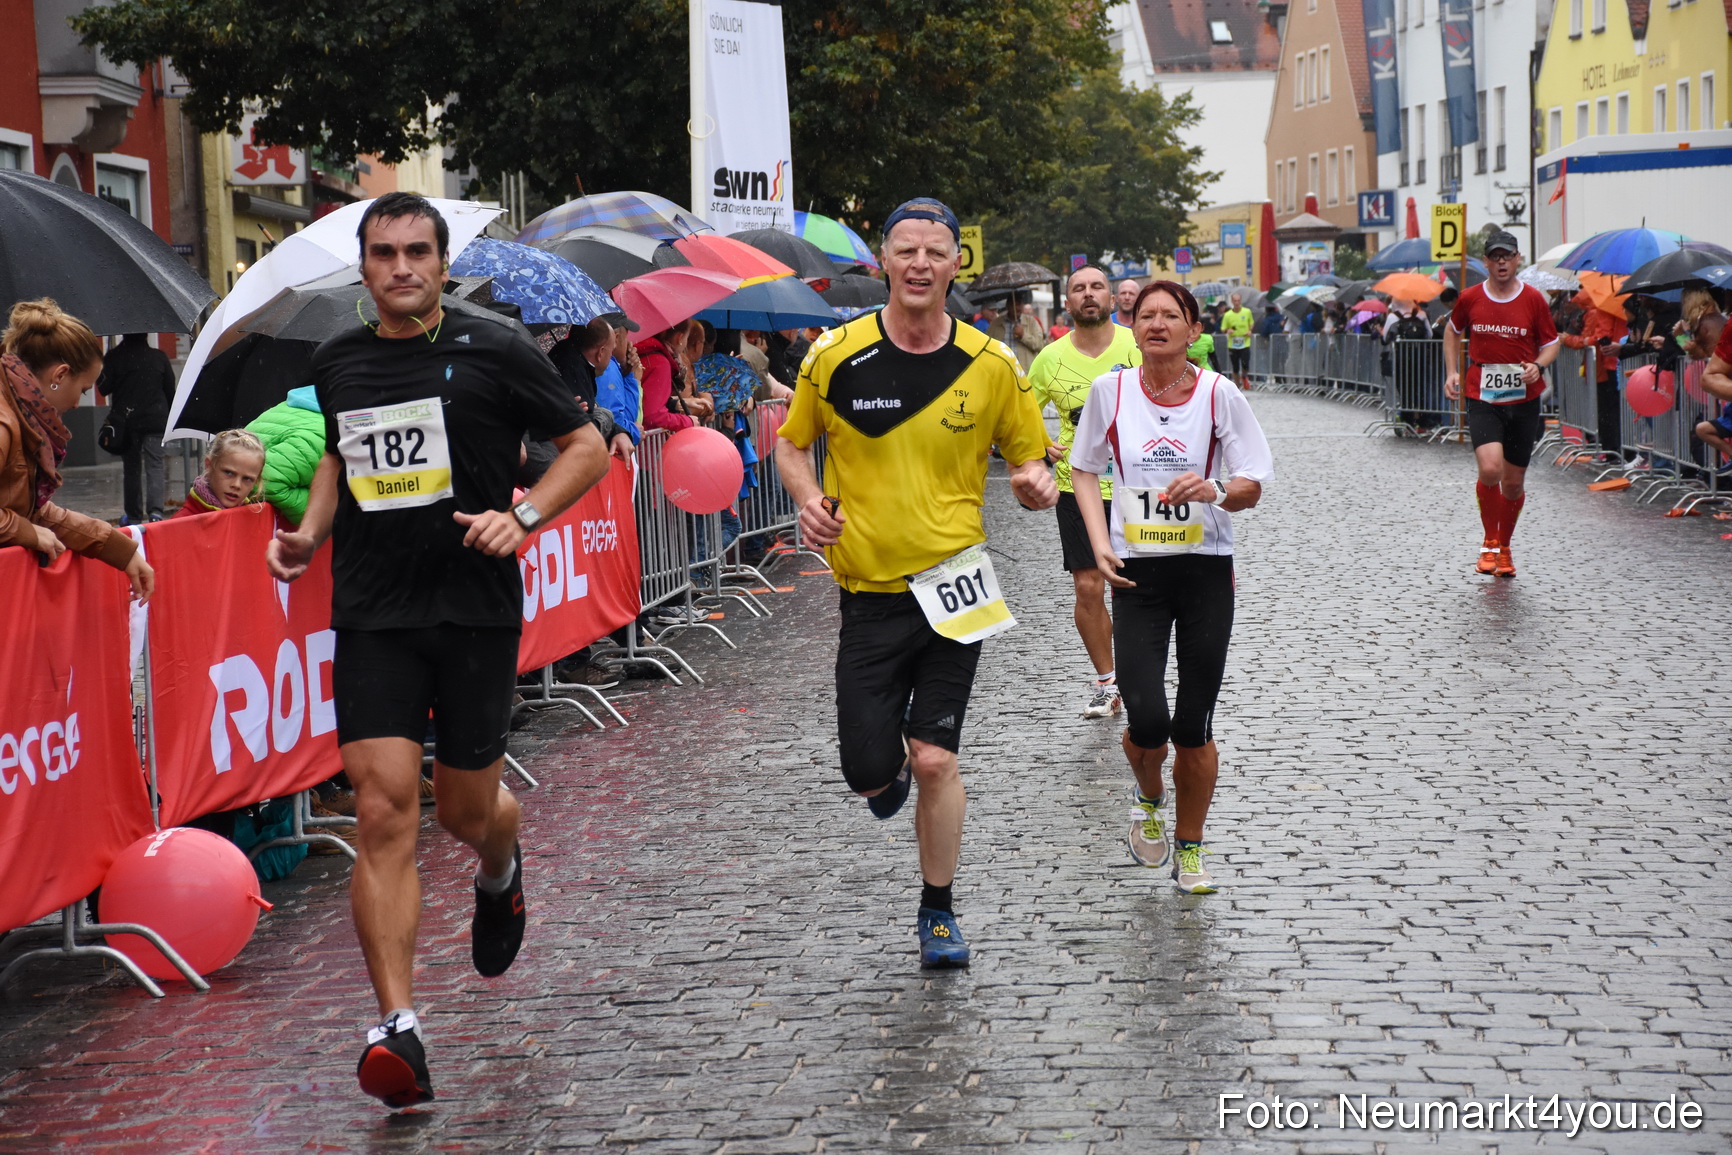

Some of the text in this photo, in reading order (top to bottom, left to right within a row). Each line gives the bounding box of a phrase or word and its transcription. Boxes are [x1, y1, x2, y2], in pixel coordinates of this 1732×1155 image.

[714, 38, 726, 54] SIE
[1583, 63, 1607, 91] HOTEL
[713, 166, 768, 200] swn
[1435, 206, 1463, 216] Block
[960, 229, 978, 239] ock
[1440, 221, 1457, 248] D
[1472, 324, 1519, 334] NEUMARKT
[851, 348, 879, 366] STANNO
[1486, 372, 1522, 389] 2645
[954, 389, 970, 398] TSV
[382, 404, 431, 422] BOCK
[852, 398, 902, 411] Markus
[361, 427, 428, 470] 182
[376, 476, 420, 495] Daniel
[1140, 528, 1186, 543] Irmgard
[520, 524, 588, 623] ODL
[935, 567, 989, 614] 601
[208, 628, 338, 775] ROD
